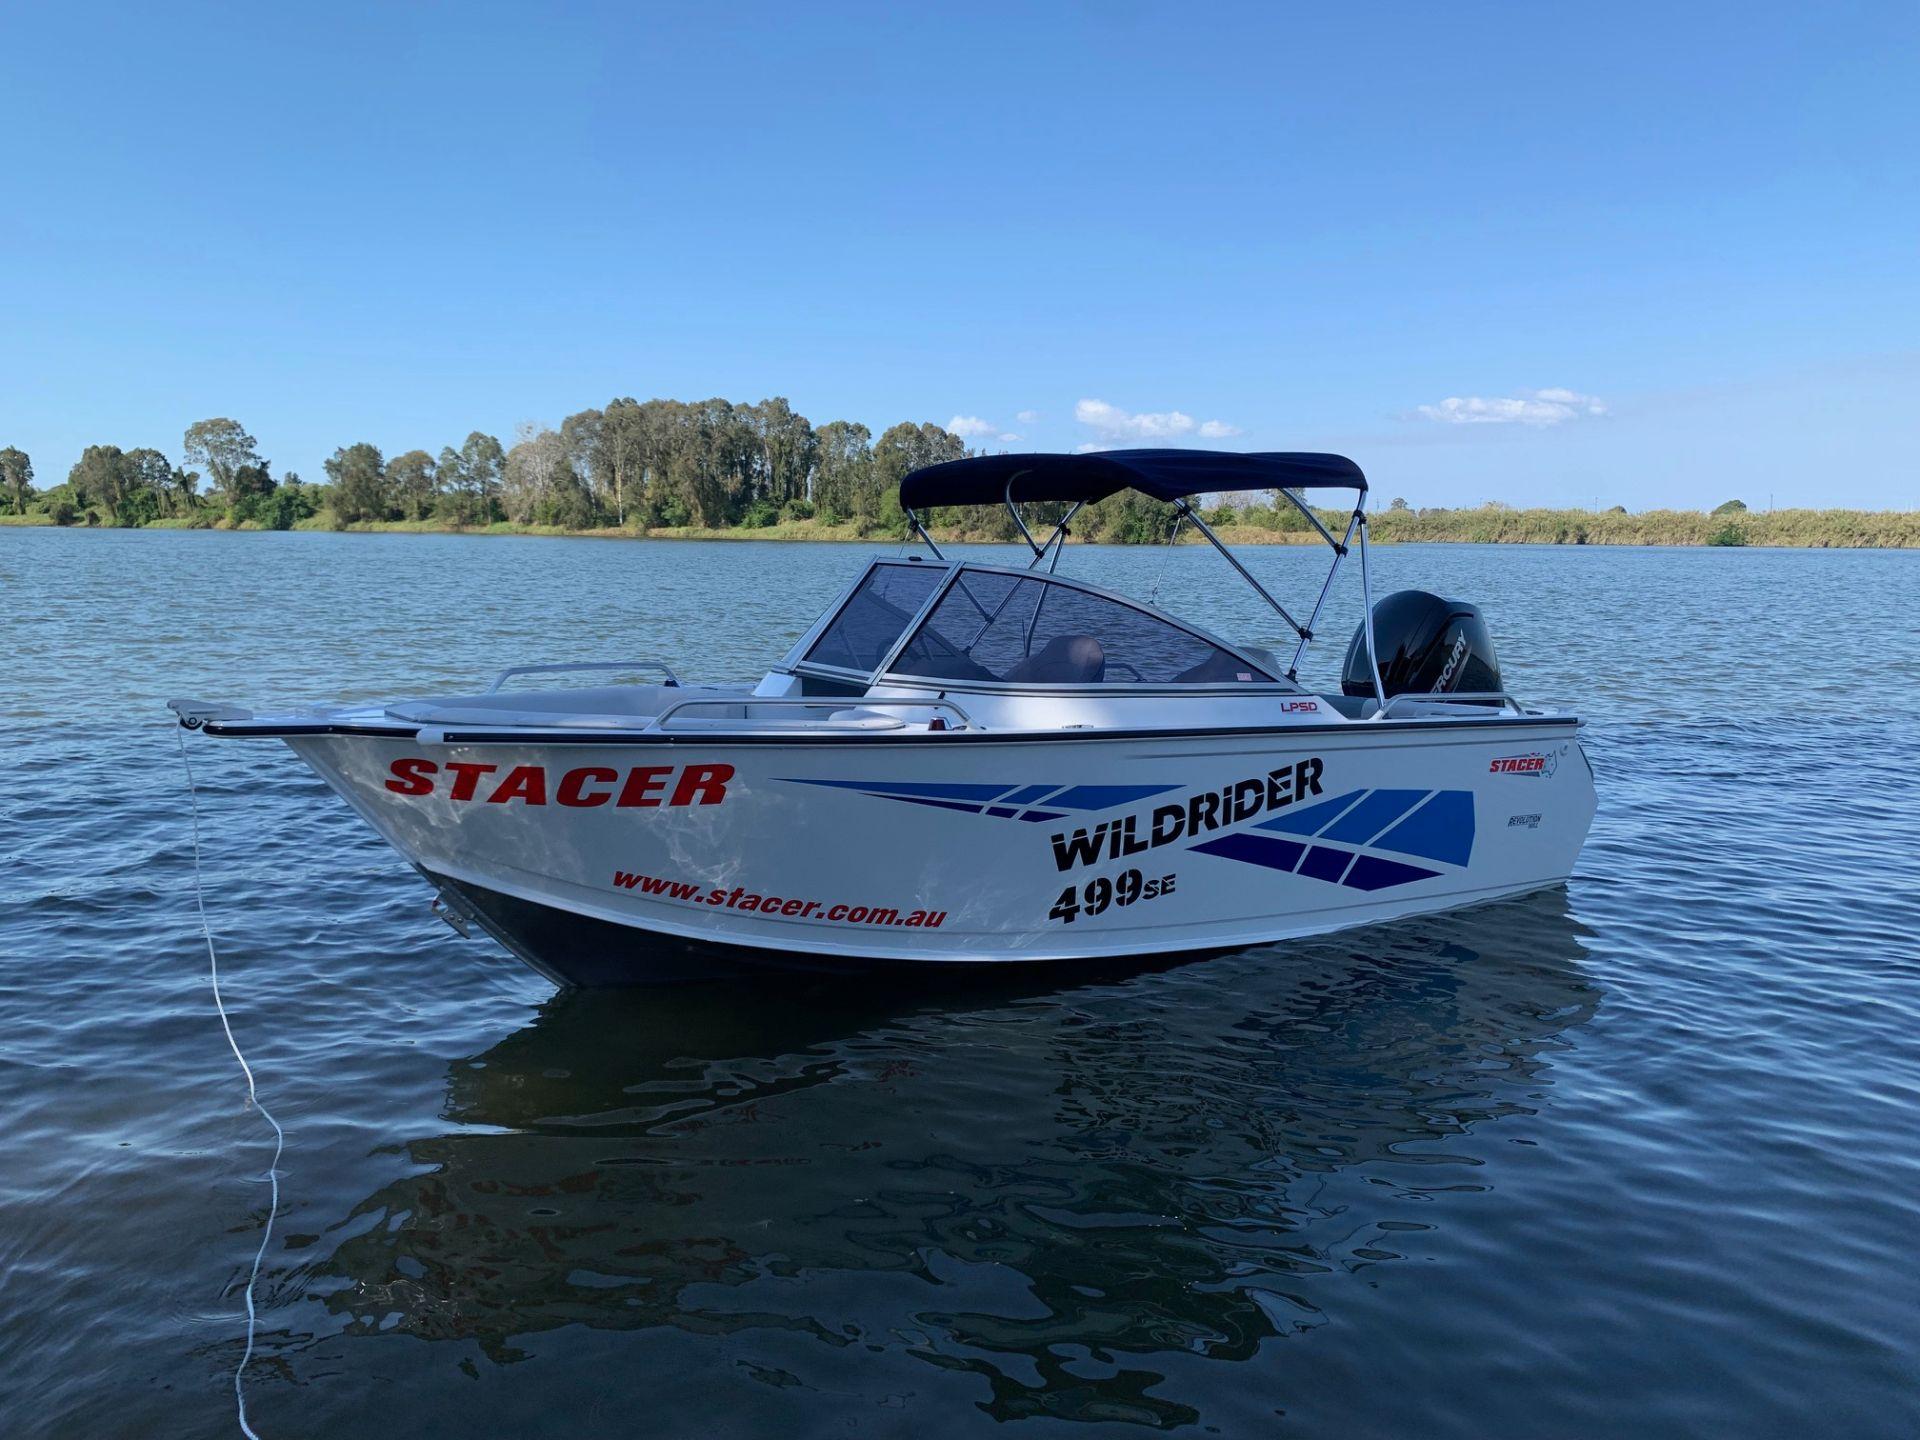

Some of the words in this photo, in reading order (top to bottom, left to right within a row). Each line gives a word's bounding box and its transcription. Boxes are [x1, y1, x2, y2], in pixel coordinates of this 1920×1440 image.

[1430, 628, 1466, 693] ERCURY
[1281, 702, 1318, 713] LPSD
[385, 758, 736, 807] STACER
[1488, 758, 1544, 773] STACER
[614, 870, 947, 928] www.stacer.com.au
